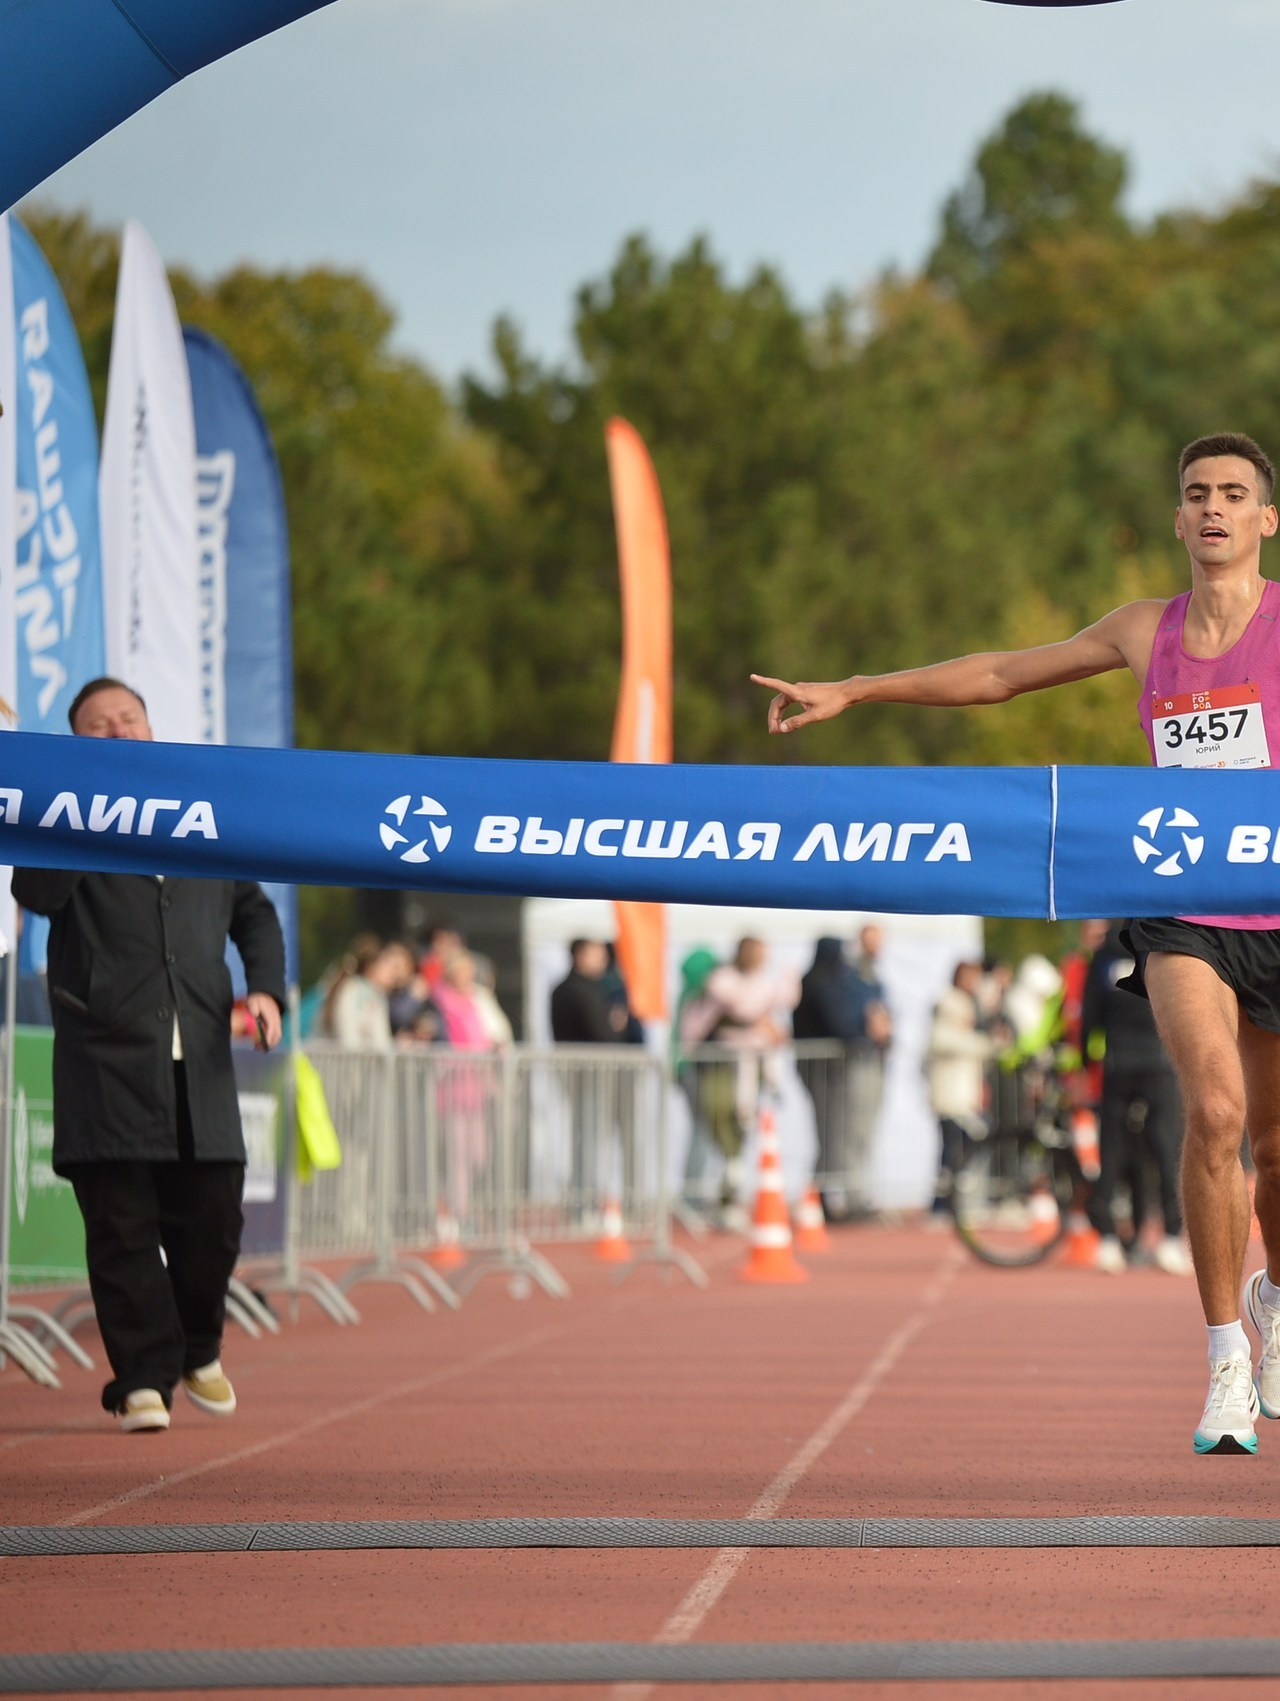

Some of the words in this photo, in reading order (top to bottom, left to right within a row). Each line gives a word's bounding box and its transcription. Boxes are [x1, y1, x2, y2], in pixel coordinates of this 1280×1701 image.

[1164, 702, 1173, 710] 10
[1164, 709, 1249, 749] 3457
[1195, 744, 1221, 755] ЮРИЙ
[39, 791, 219, 840] ЛИГА
[473, 815, 781, 862] ВЫСШАЯ
[792, 821, 972, 864] ЛИГА
